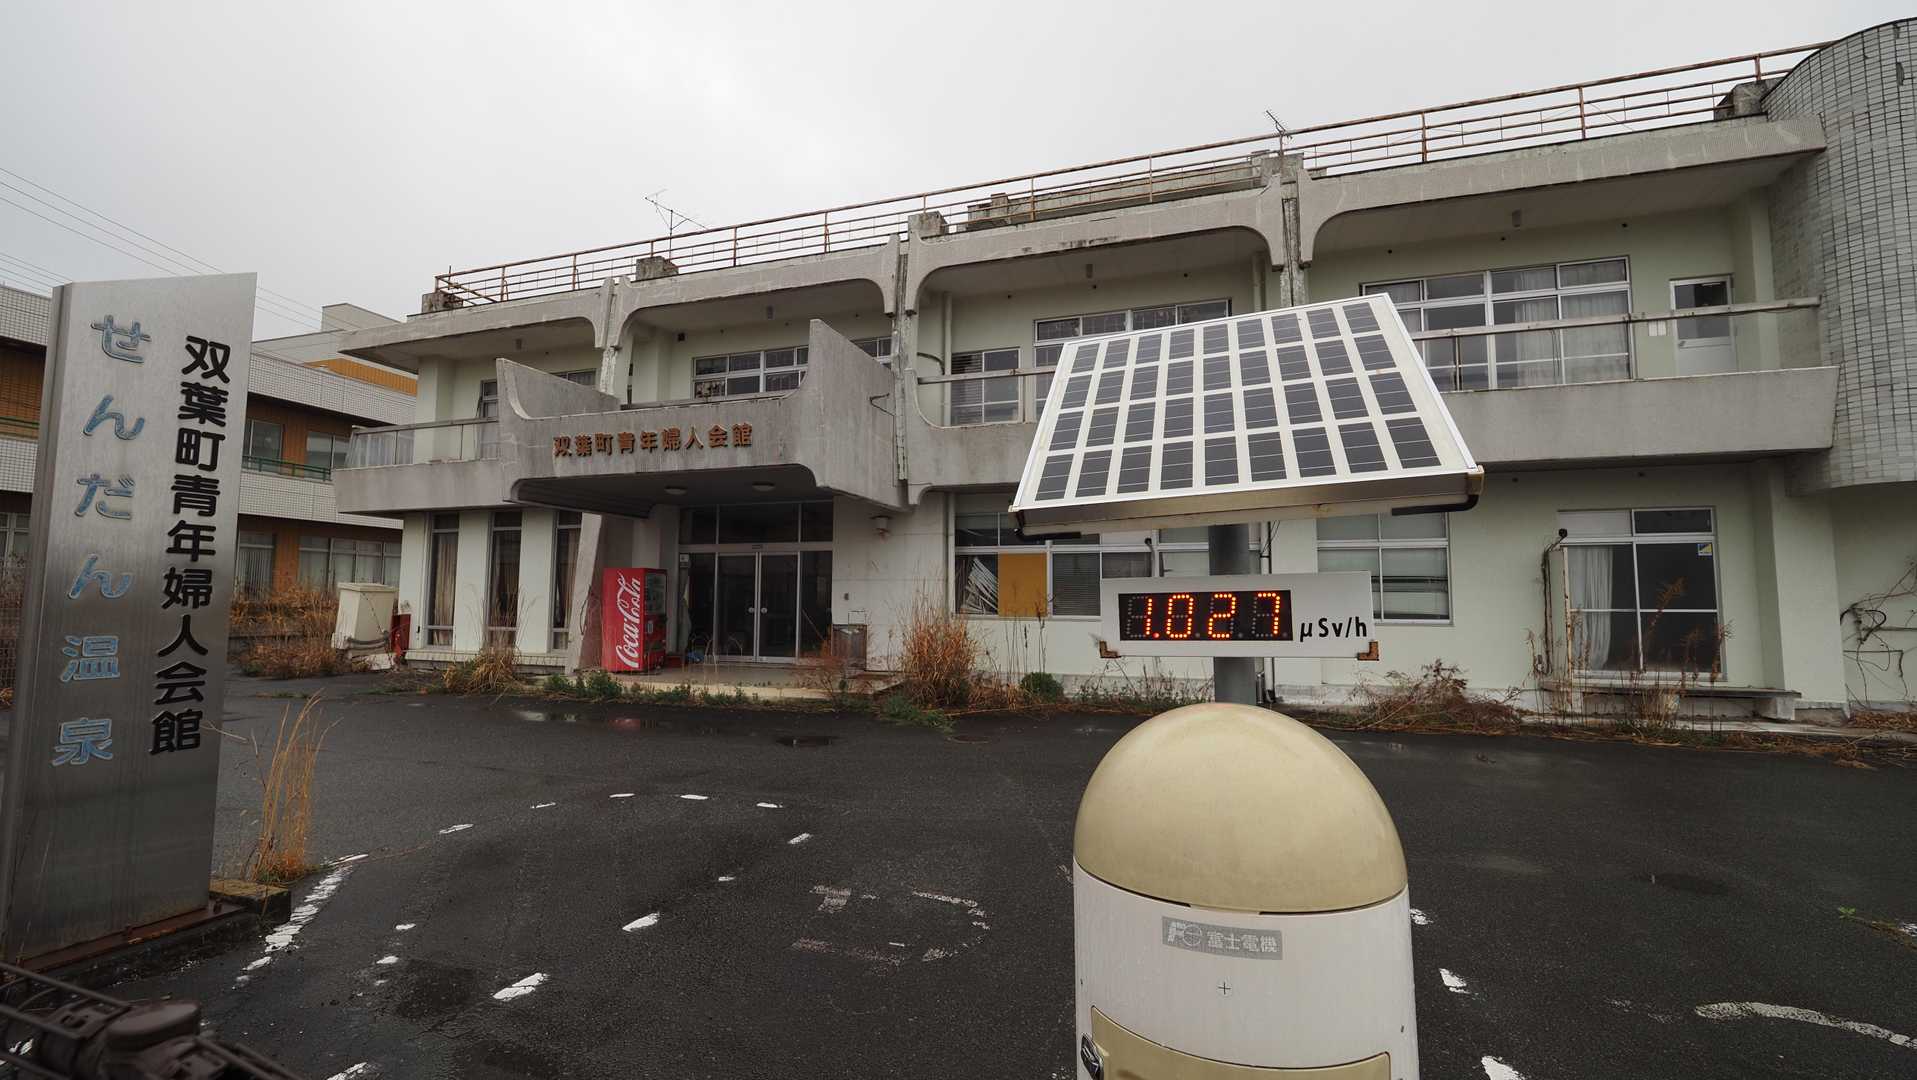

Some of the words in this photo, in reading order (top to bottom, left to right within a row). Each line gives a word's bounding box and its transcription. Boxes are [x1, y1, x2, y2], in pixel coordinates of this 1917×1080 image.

[51, 314, 151, 766] せんだん温泉
[150, 335, 231, 756] 双葉町青年婦人会館
[553, 422, 753, 457] 双葉町青年婦人会館
[1145, 593, 1281, 639] 1.027
